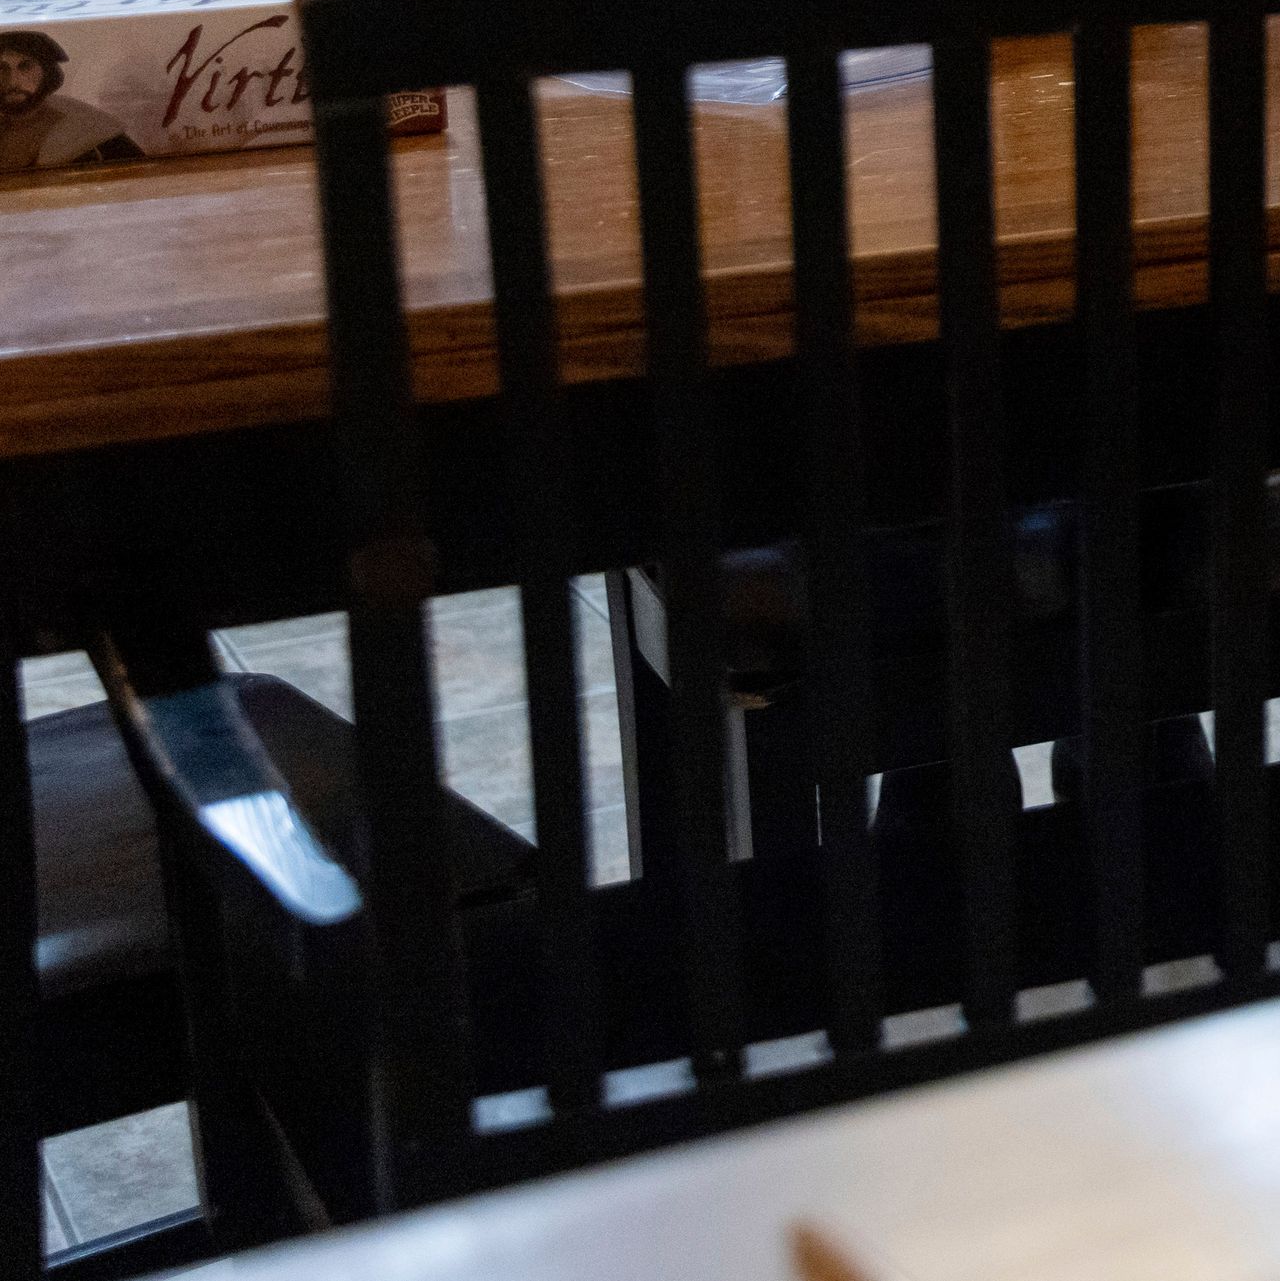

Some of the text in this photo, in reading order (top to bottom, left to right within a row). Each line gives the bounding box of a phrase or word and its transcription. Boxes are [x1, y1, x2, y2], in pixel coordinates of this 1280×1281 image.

[390, 94, 429, 108] UPER
[390, 103, 438, 122] EEPLE
[183, 126, 208, 139] The
[212, 123, 231, 136] Art
